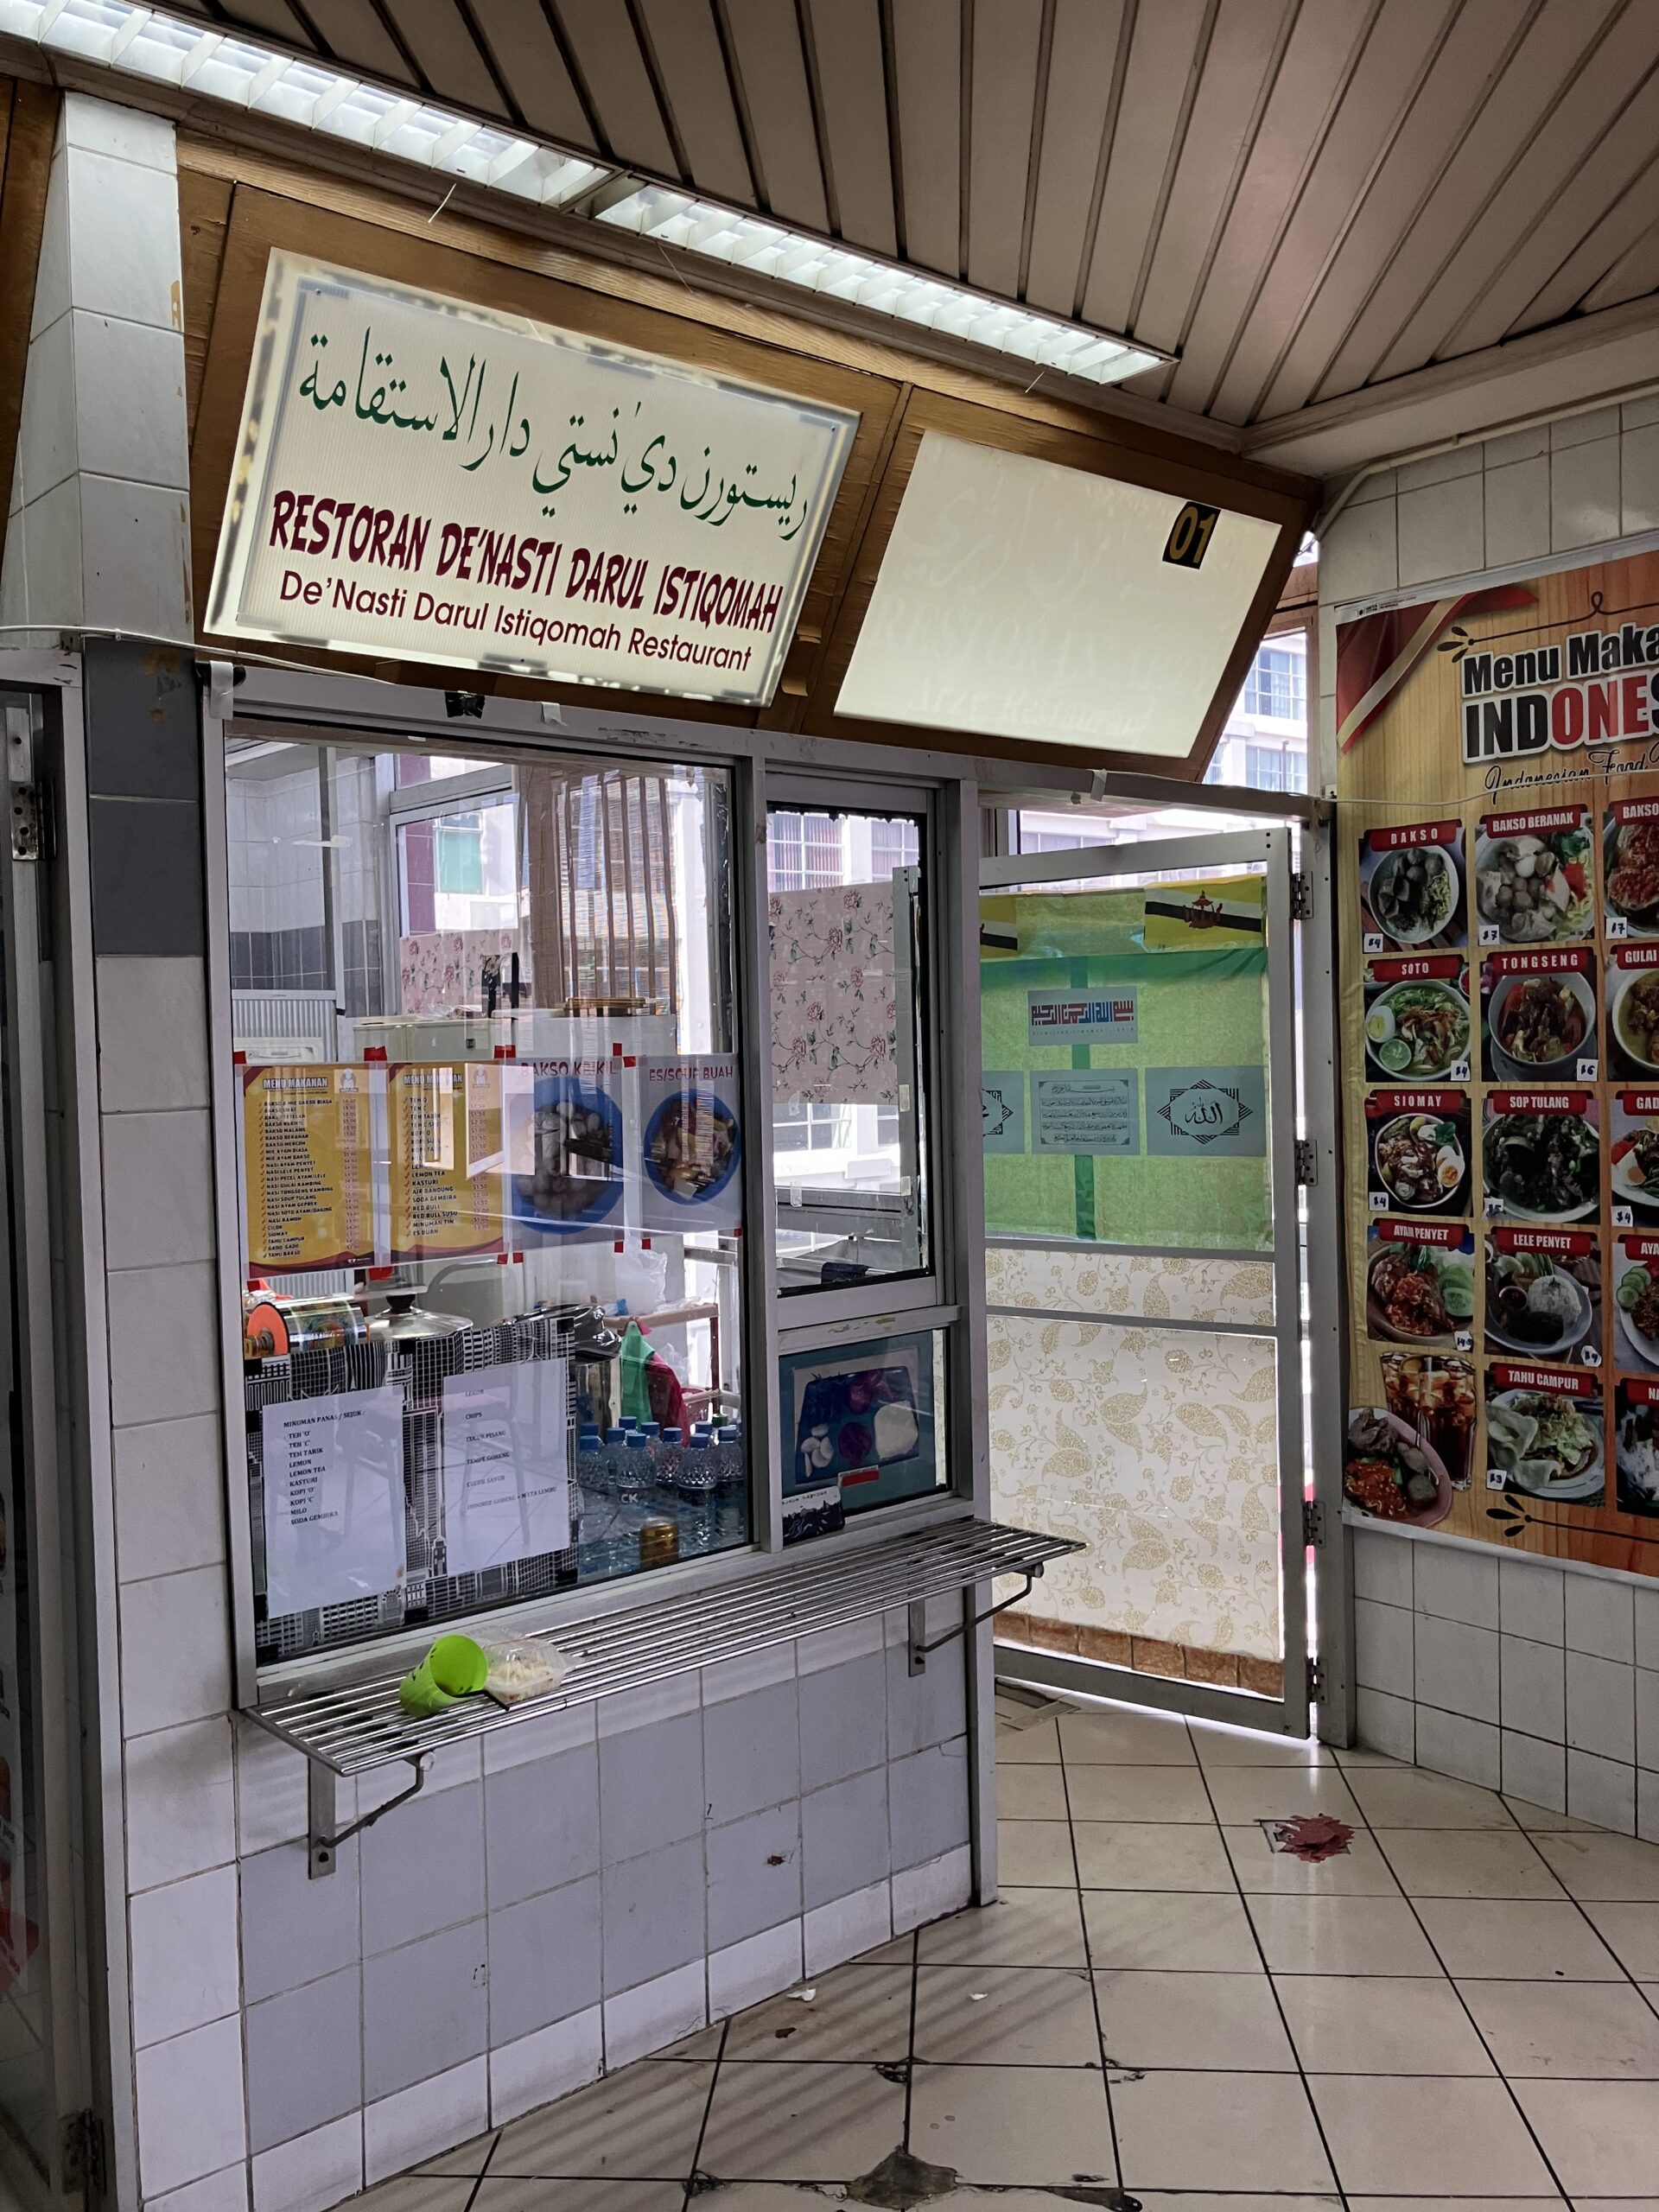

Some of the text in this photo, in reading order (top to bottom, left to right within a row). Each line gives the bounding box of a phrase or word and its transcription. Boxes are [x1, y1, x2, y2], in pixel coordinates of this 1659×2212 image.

[1169, 505, 1216, 563] 01
[270, 489, 785, 634] RESTORAN DE'NASTI DARUL ISTIQOMAH
[279, 569, 752, 672] De'Nasti Darul Istiqomah Restaurant
[1464, 647, 1560, 695] Menu
[1623, 803, 1659, 818] BAKSO
[1492, 812, 1573, 832] BAKSO BERANAK
[1390, 829, 1439, 844] BAKSO
[1502, 954, 1578, 969] TONGSENG
[1624, 950, 1657, 963] GULAI
[1401, 962, 1429, 975] SOTO
[521, 1061, 569, 1077] BAKSO
[703, 1066, 733, 1079] BUAH
[263, 1077, 328, 1089] MENU MAKANAN
[1394, 1095, 1441, 1107] SIOMAY
[1510, 1096, 1569, 1109] SOP TULANG
[1394, 1224, 1449, 1241] AYAM PENYET
[1514, 1234, 1571, 1249] LELE PENYET
[1508, 1370, 1579, 1390] TAHU CAMPUR
[283, 1417, 315, 1428] MINUMAN
[343, 1410, 362, 1419] SEJUK
[303, 1447, 323, 1456] TARIK
[486, 1452, 510, 1461] GORENG
[289, 1459, 312, 1468] LEMON
[289, 1469, 312, 1478] LEMON
[289, 1477, 318, 1487] KASTURI
[289, 1488, 306, 1497] KOPI
[289, 1497, 307, 1506] KOPI
[290, 1507, 307, 1516] MILO
[290, 1516, 308, 1525] SODA
